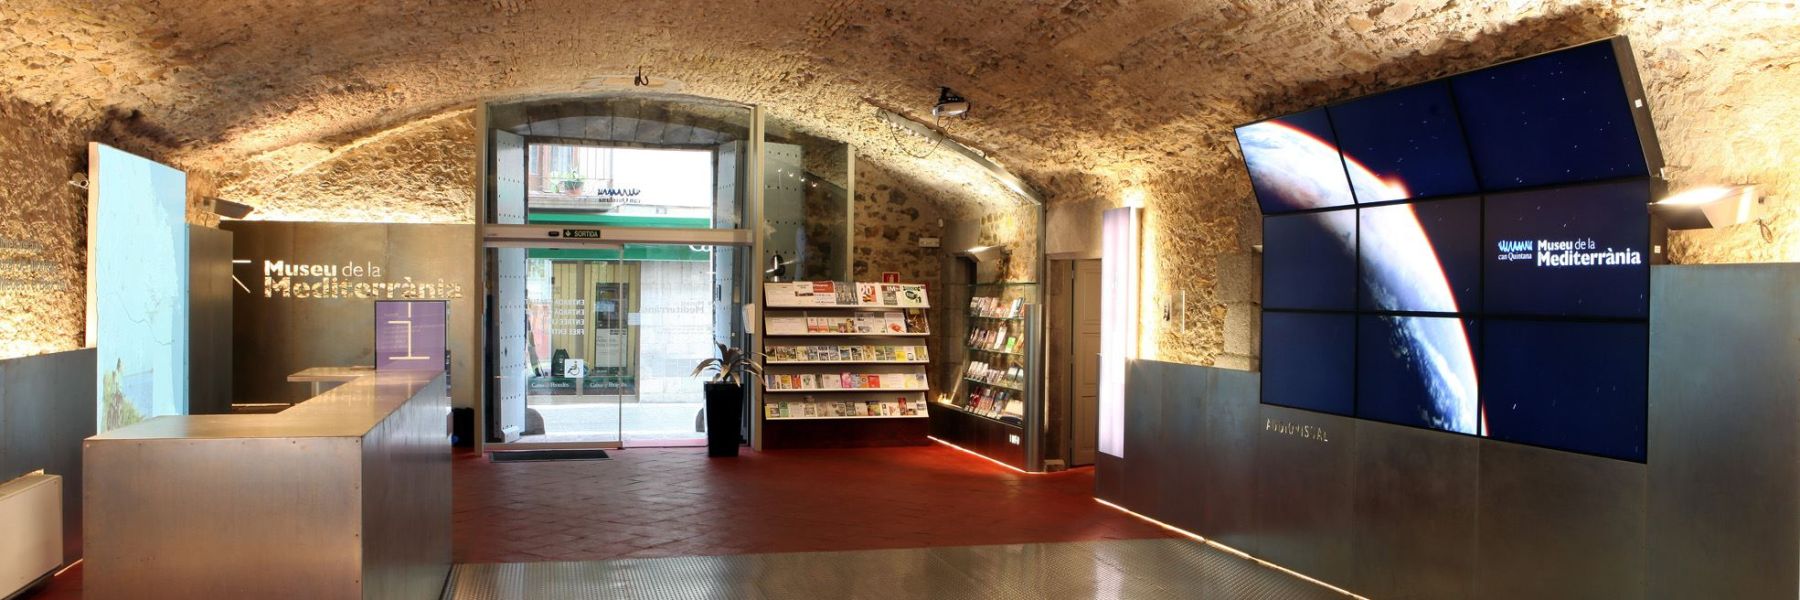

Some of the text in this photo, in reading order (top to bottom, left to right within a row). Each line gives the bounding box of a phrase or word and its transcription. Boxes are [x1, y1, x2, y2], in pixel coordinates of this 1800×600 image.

[574, 230, 599, 238] SORTIDA
[1537, 237, 1596, 251] Museu de la
[1508, 252, 1533, 261] Quintana
[1537, 247, 1642, 267] Mediterrània
[264, 259, 382, 278] Museu de la
[263, 276, 464, 299] Mediterrània
